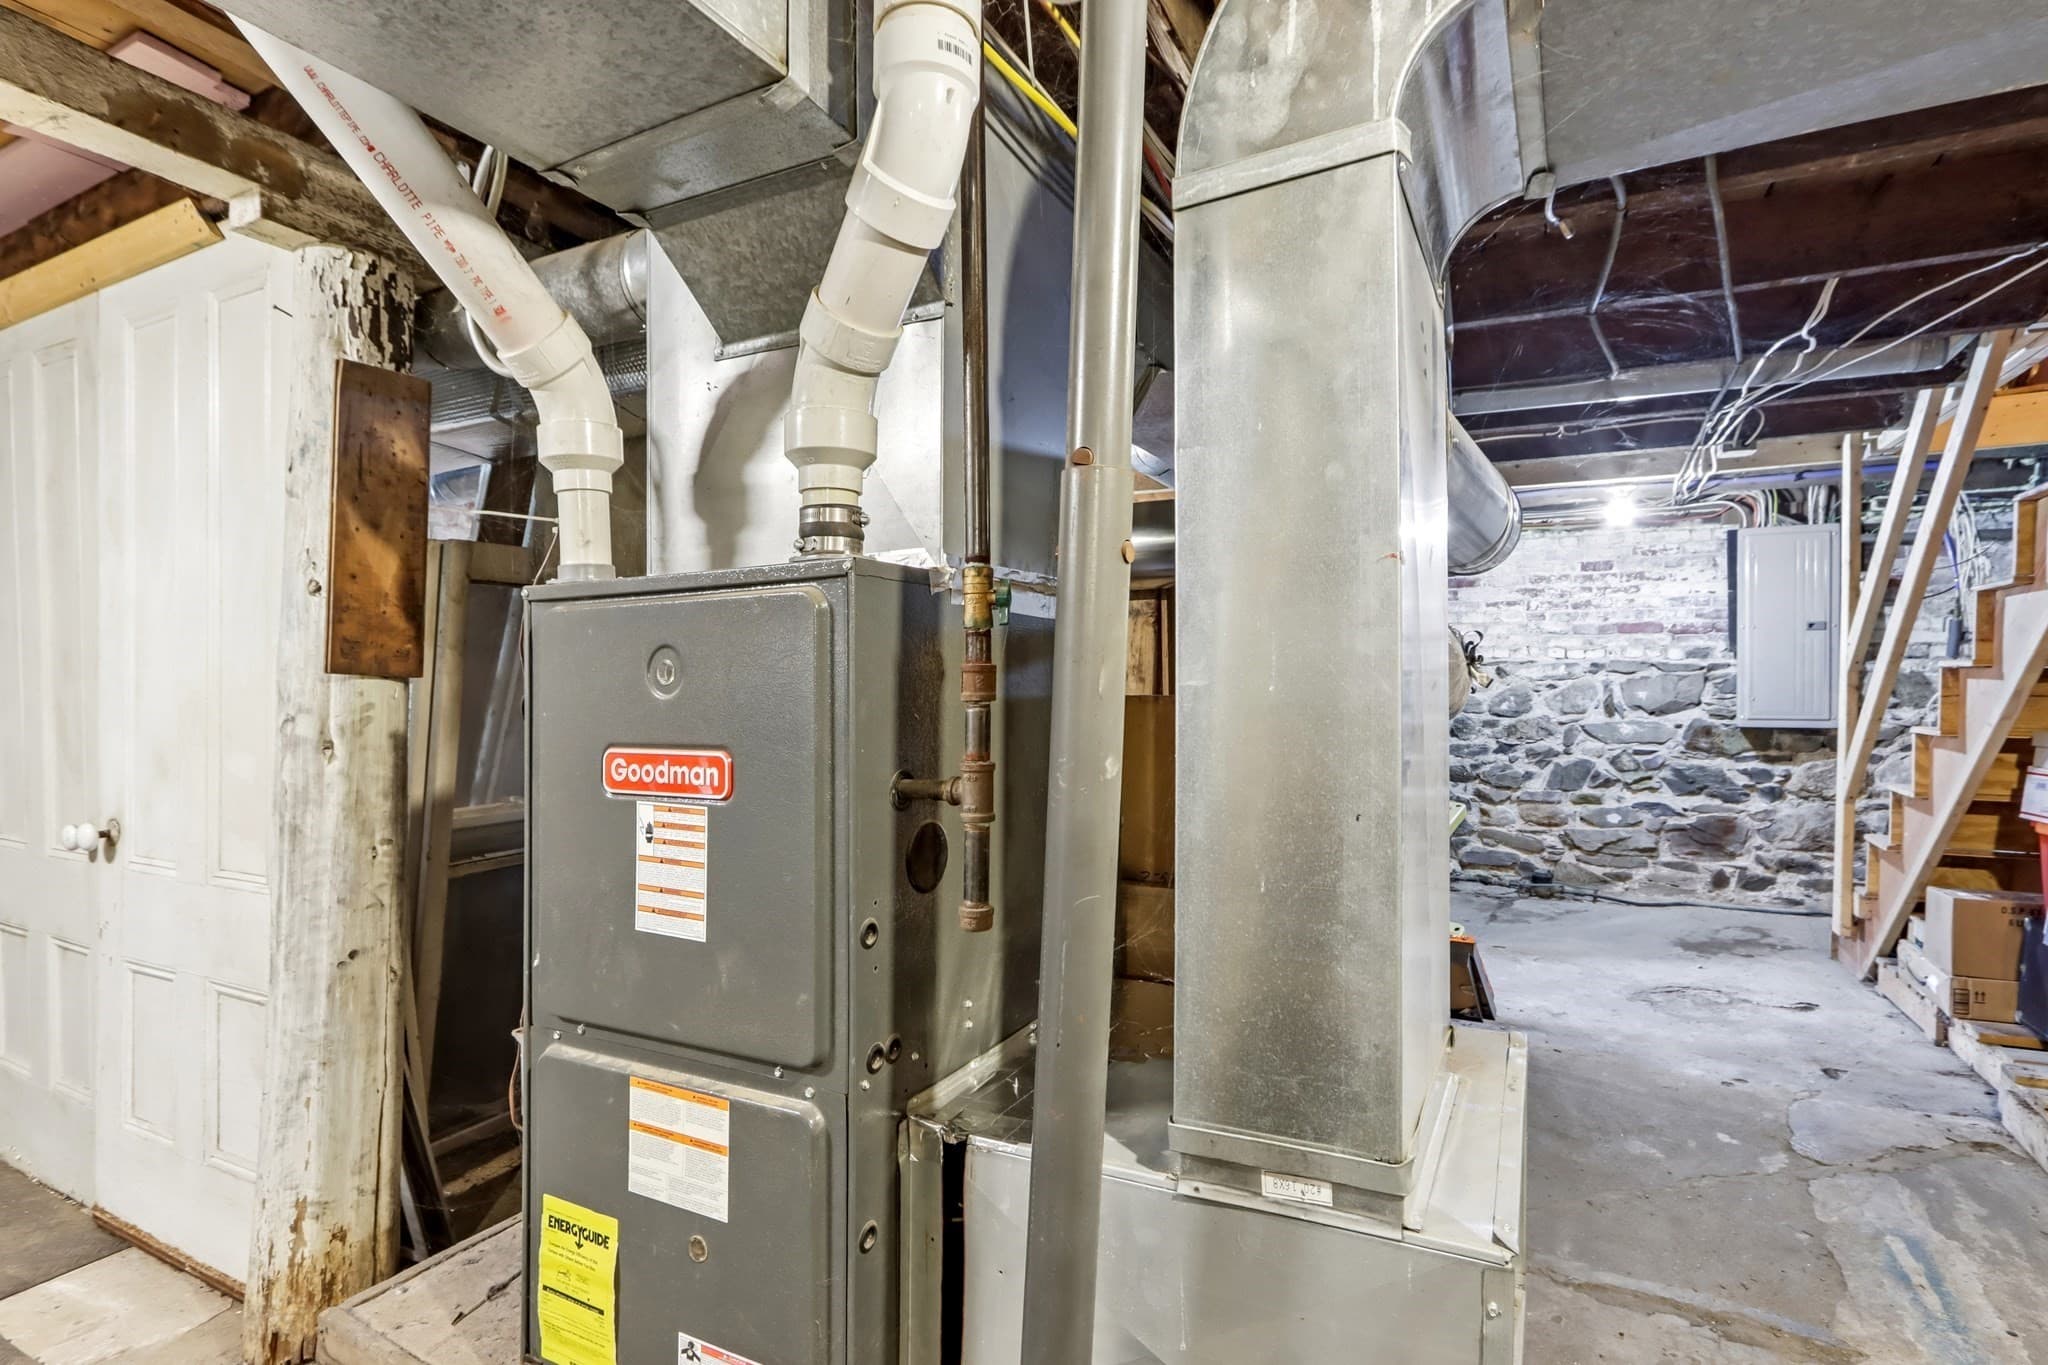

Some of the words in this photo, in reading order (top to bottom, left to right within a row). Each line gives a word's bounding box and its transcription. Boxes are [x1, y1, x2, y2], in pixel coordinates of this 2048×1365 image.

[373, 151, 423, 210] CHARLOTTE
[421, 212, 446, 239] PIPE
[610, 757, 719, 787] Goodman
[547, 1214, 610, 1250] ENERGYGUIDE
